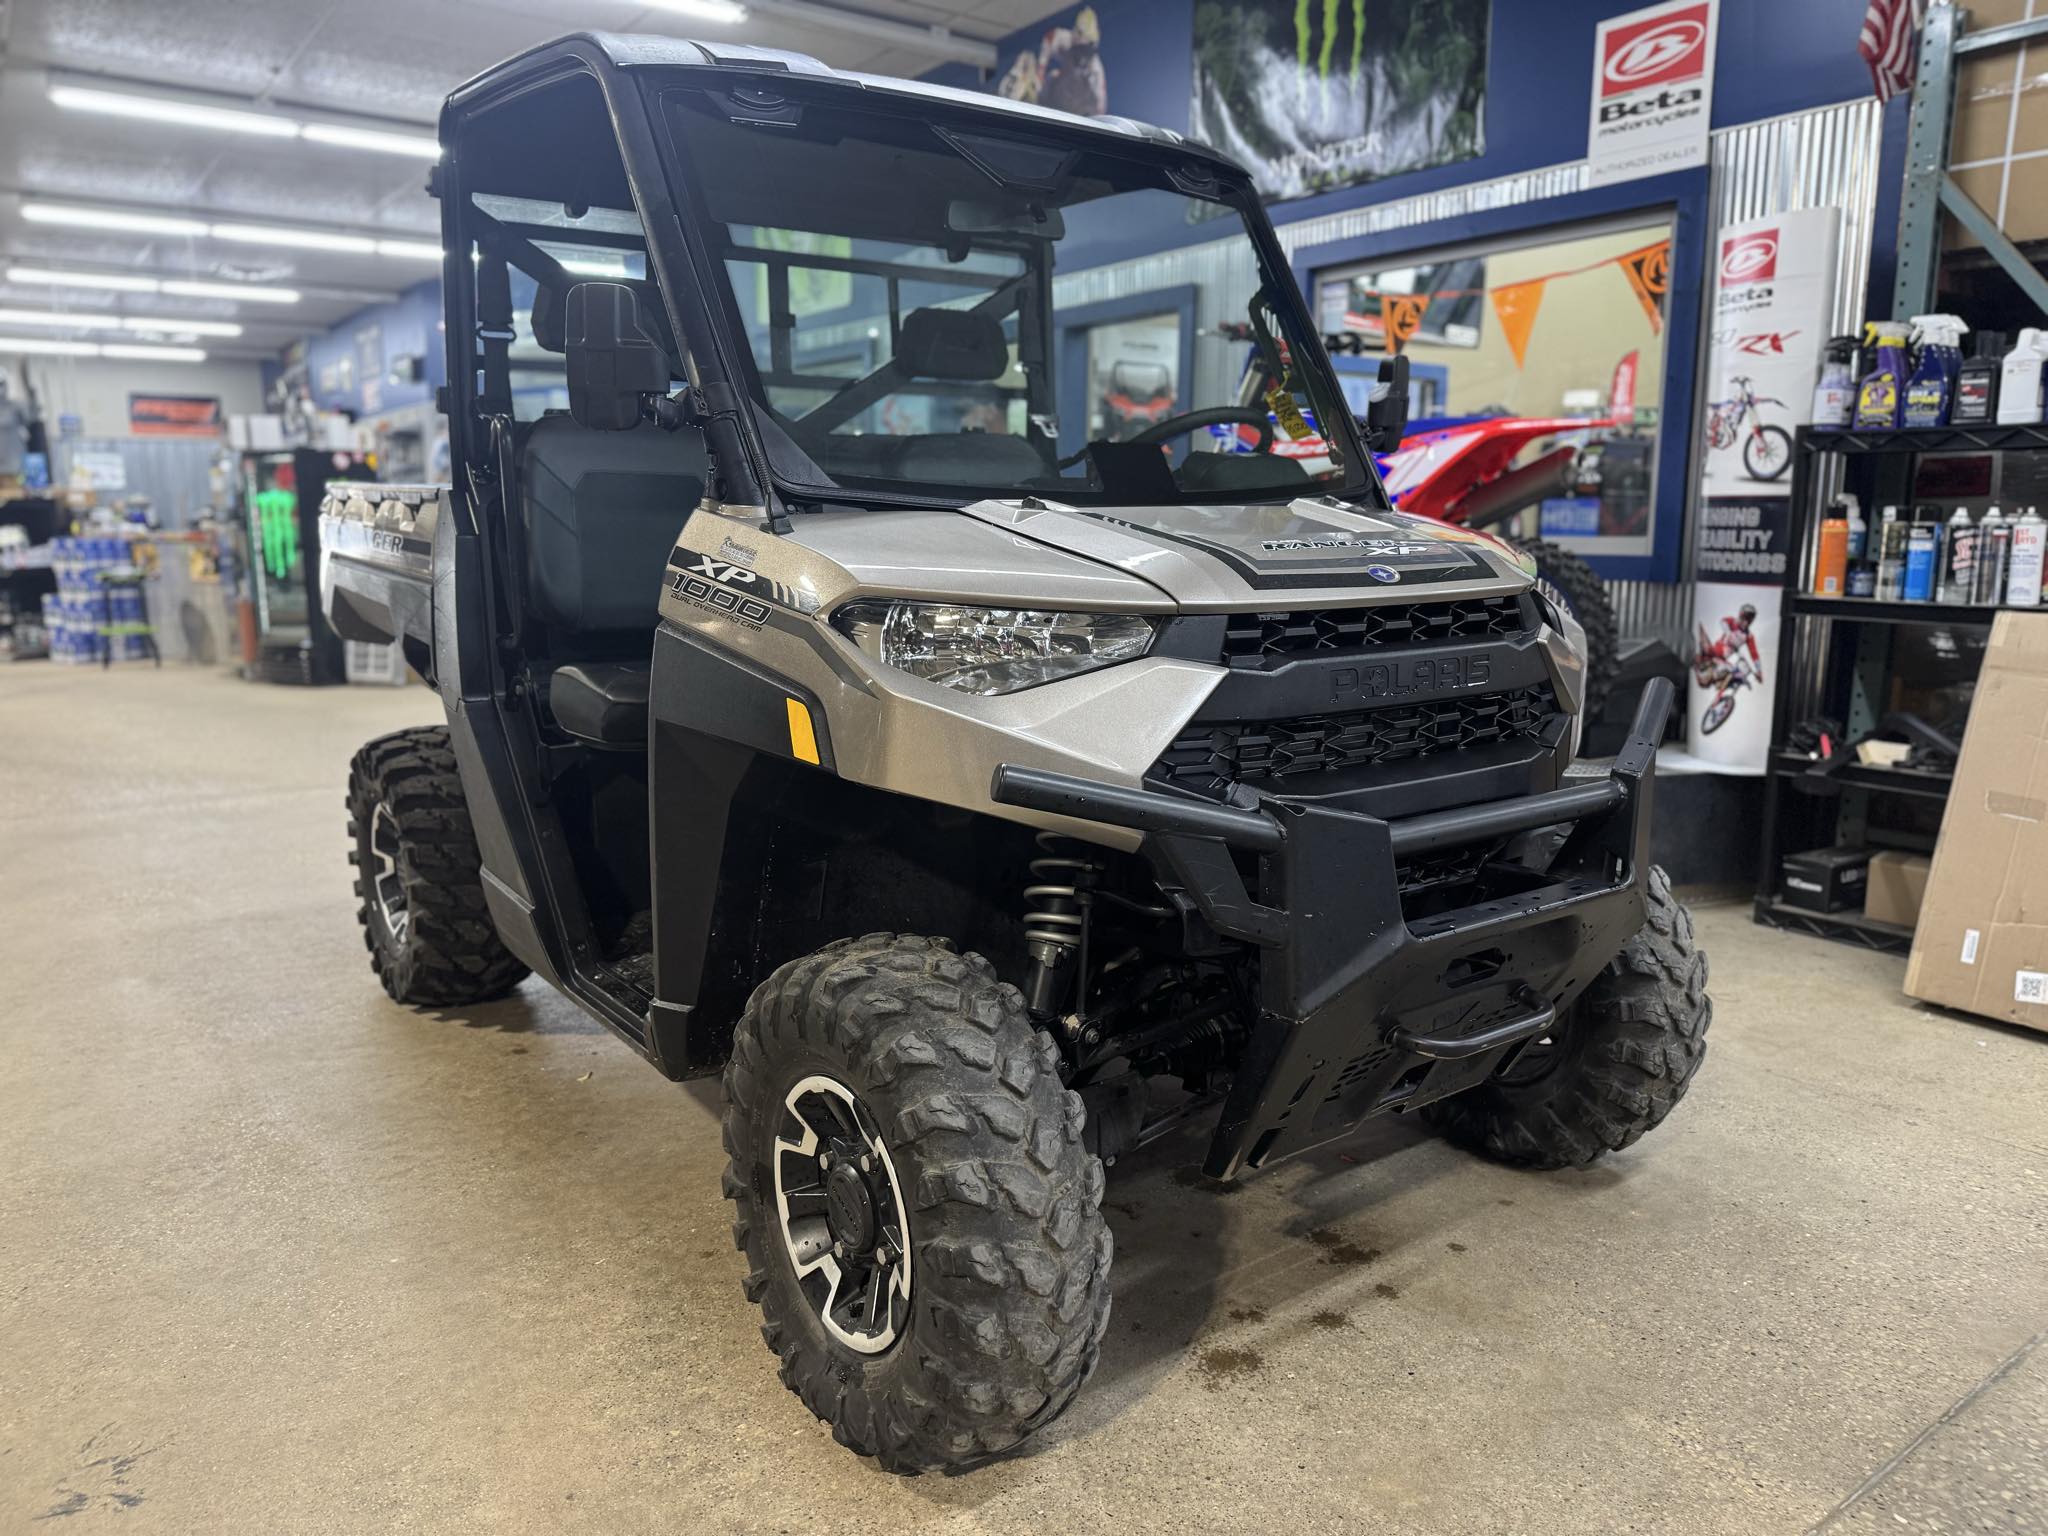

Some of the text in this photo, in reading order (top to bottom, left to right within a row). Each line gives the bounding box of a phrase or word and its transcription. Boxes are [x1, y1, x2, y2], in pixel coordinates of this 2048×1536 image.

[1599, 107, 1700, 137] motorcycles
[1600, 89, 1702, 124] Beta
[1261, 538, 1400, 551] RANGER
[1362, 546, 1429, 557] XP
[687, 554, 756, 584] XP
[670, 592, 762, 633] DUAL OVERHEAD CAM
[671, 571, 773, 625] 1000
[1330, 654, 1490, 703] POLARIS
